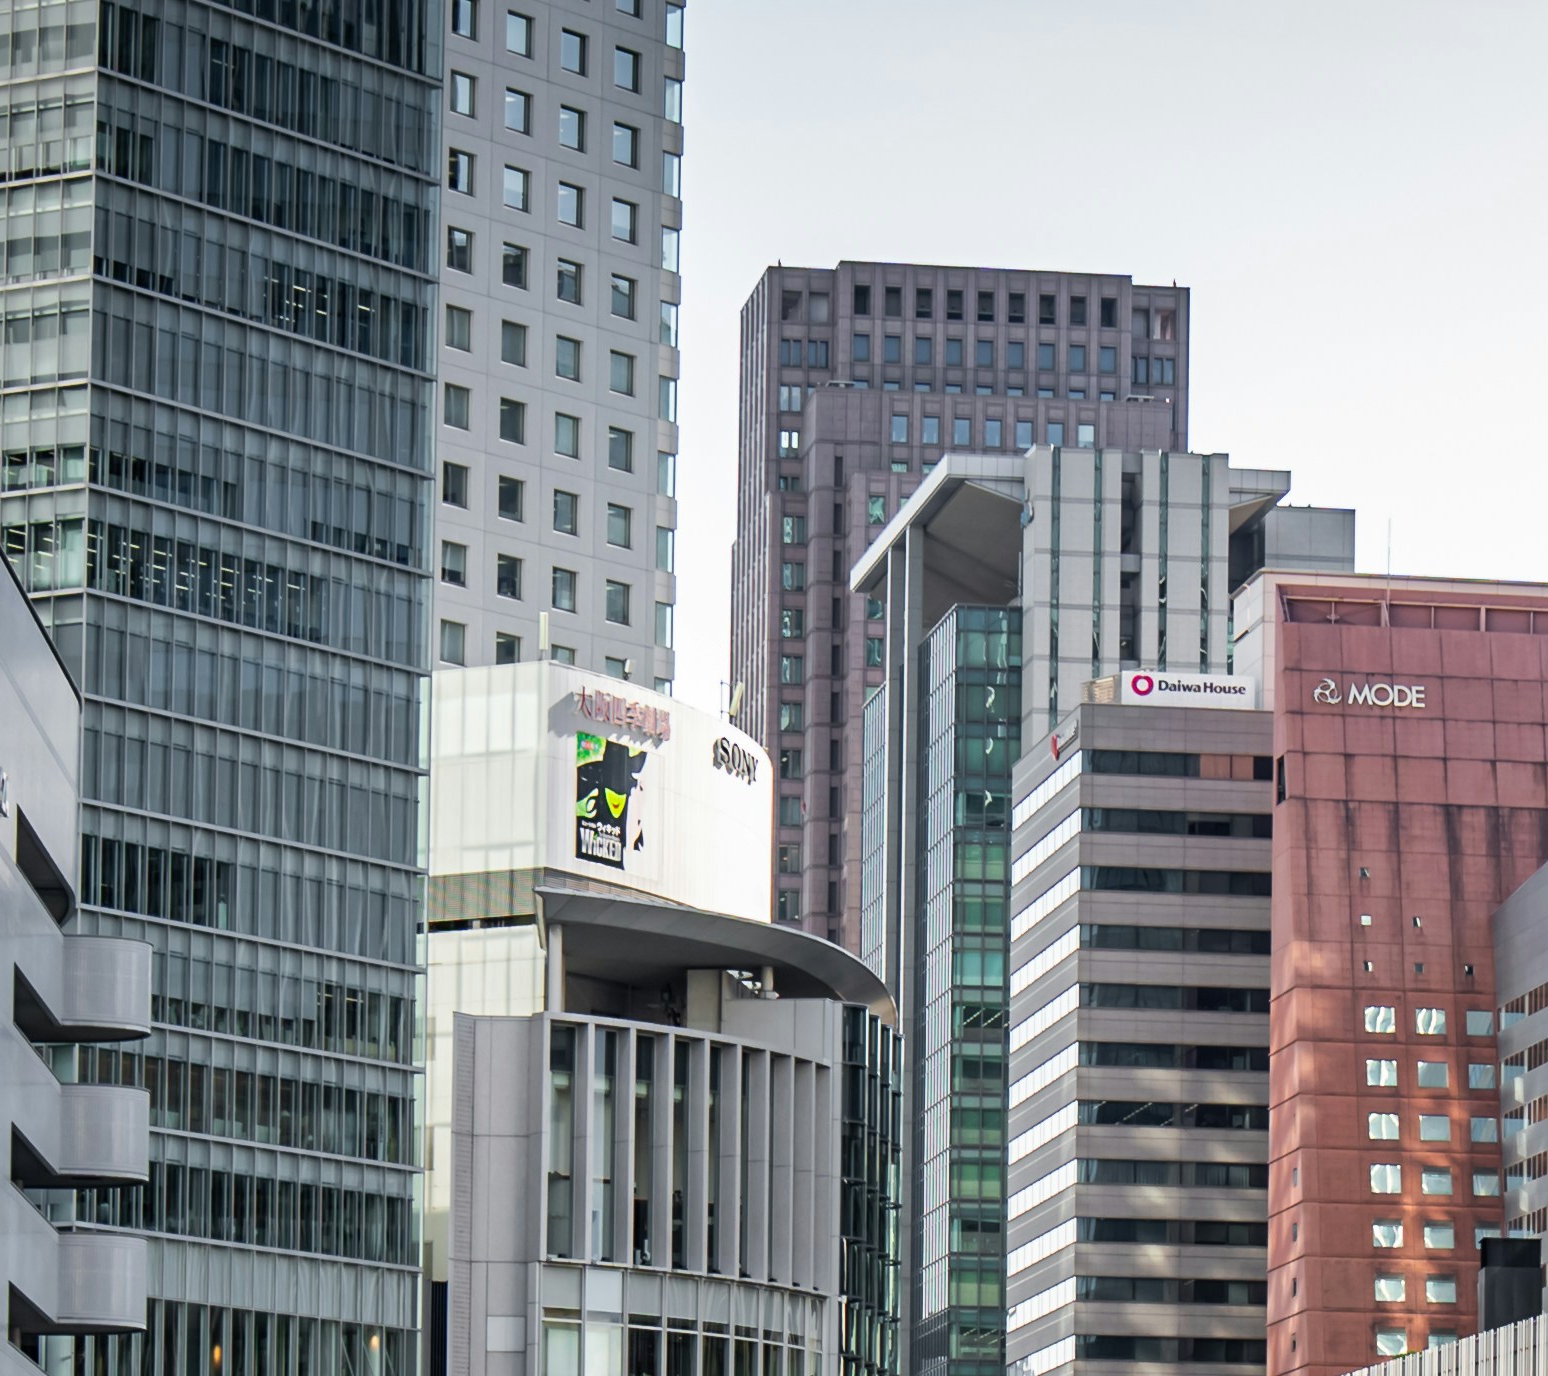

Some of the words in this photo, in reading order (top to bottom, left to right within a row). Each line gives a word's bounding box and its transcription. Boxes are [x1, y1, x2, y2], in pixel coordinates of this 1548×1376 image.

[1158, 680, 1201, 693] Daiwa
[1203, 683, 1247, 695] House
[1347, 683, 1426, 708] MODE
[718, 736, 759, 785] SONY
